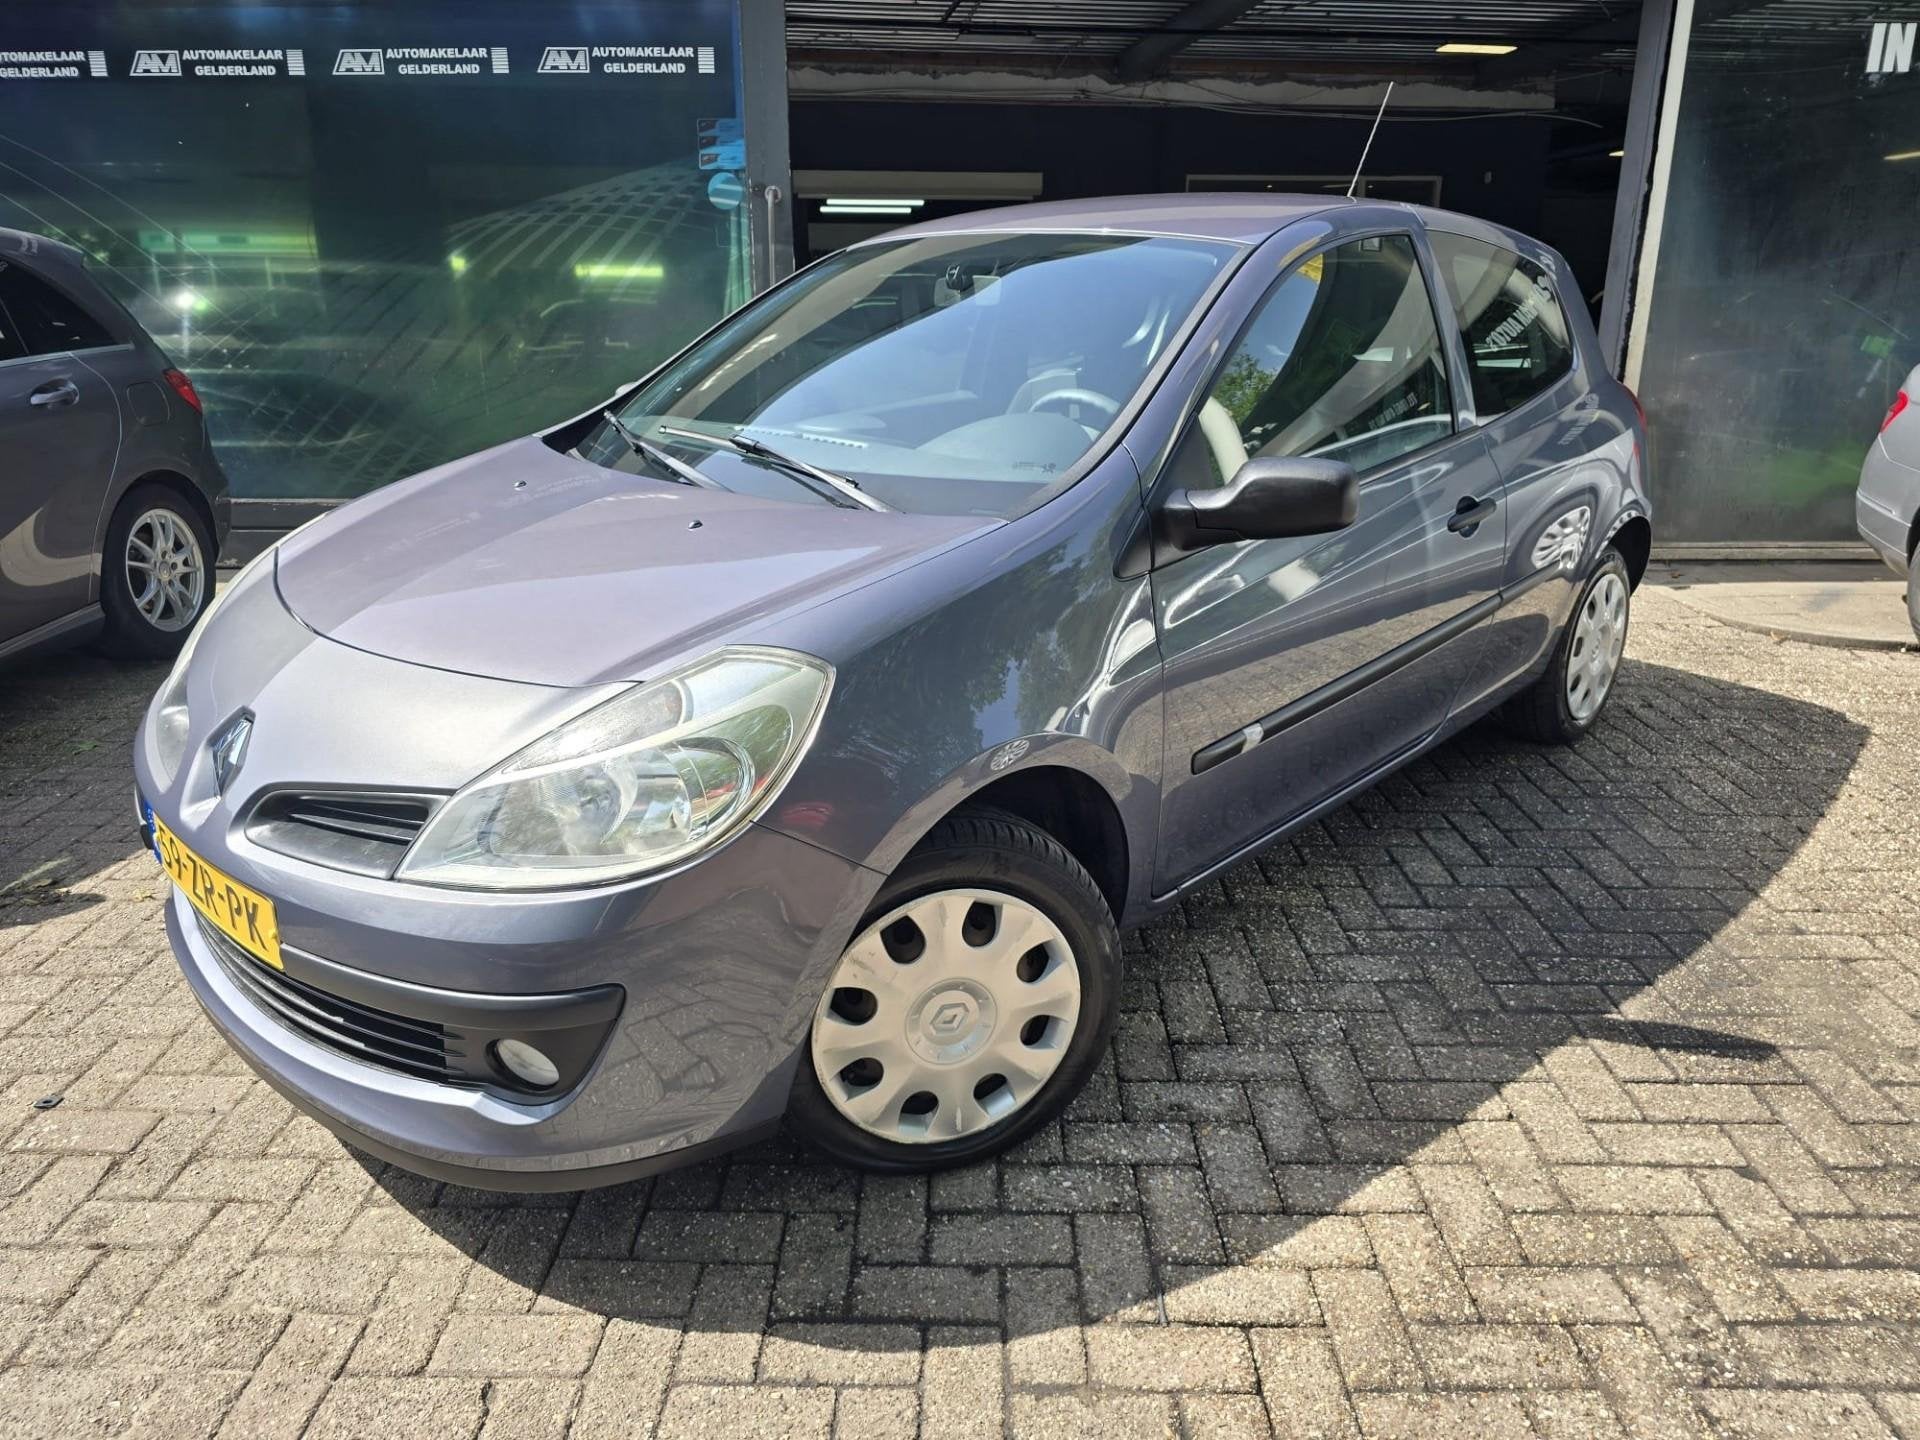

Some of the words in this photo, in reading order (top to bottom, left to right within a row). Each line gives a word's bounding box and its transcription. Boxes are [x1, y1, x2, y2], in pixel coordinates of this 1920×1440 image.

[385, 47, 488, 59] AUTOMAKELAAR
[591, 46, 694, 58] AUTOMAKELAAR
[1865, 22, 1918, 73] IN
[182, 49, 284, 61] AUTOMAKELAAR
[544, 50, 587, 70] AM
[135, 53, 178, 73] AM
[338, 52, 381, 72] AM
[0, 67, 79, 78] GELDERLAND
[194, 65, 276, 76] GELDERLAND
[398, 63, 480, 75] GELDERLAND
[603, 63, 686, 74] GELDERLAND
[157, 823, 270, 953] 59-ZR-PK
